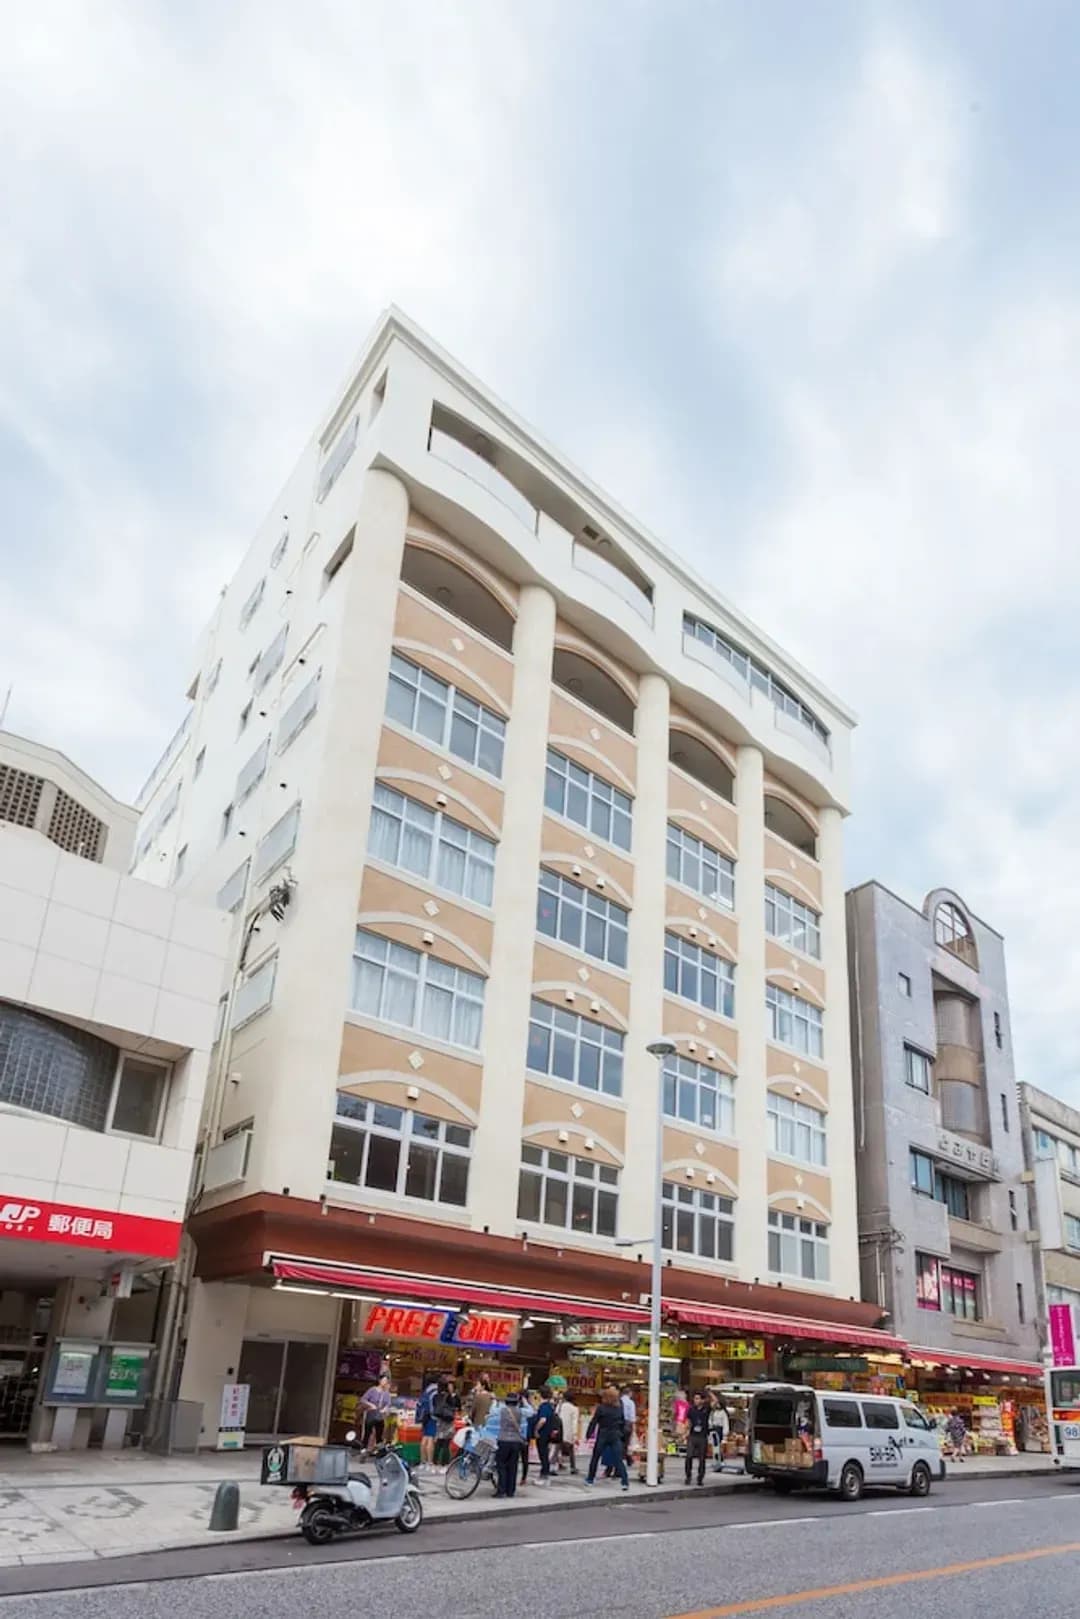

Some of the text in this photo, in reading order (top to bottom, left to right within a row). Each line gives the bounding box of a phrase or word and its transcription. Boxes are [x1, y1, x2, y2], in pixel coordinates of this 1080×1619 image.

[0, 1203, 41, 1223] JP
[0, 1223, 35, 1233] OST
[47, 1214, 113, 1240] 郵便局
[364, 1305, 514, 1345] FREE ONE
